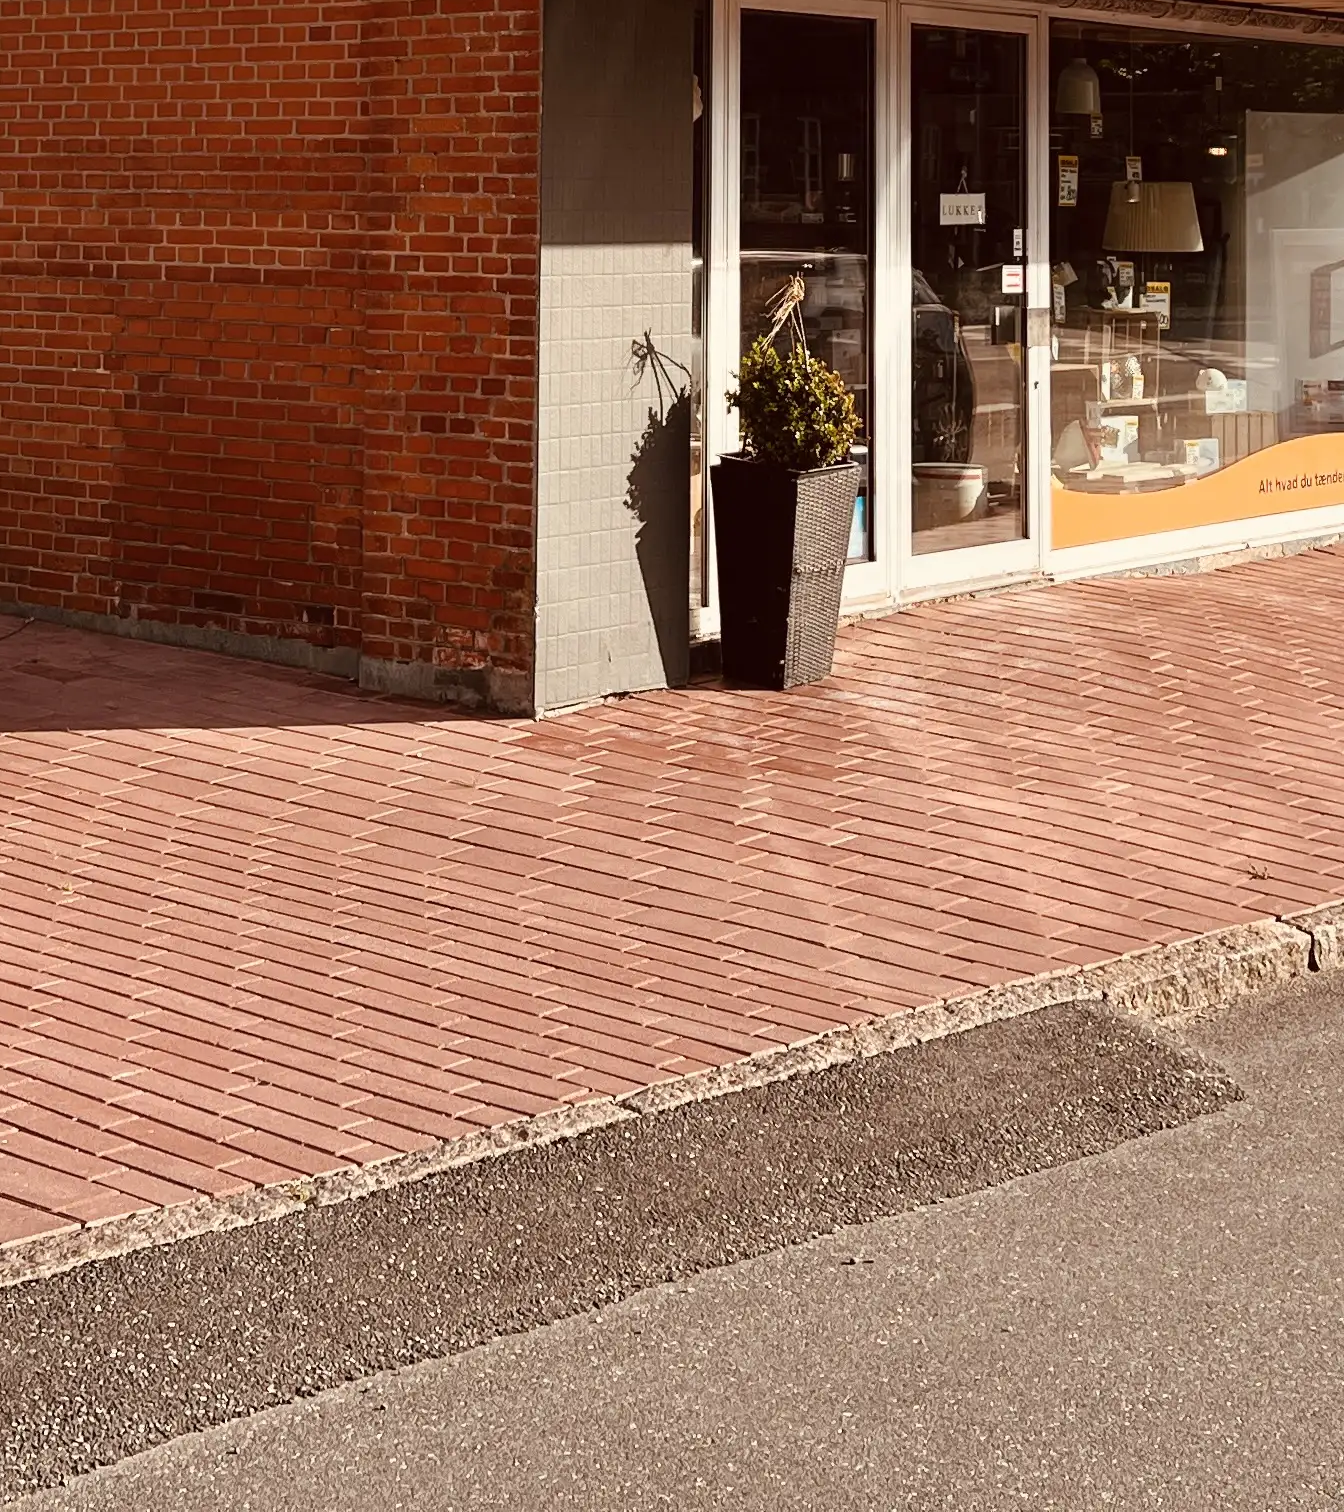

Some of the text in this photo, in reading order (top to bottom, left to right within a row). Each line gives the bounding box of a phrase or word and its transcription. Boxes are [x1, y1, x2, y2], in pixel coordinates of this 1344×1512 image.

[1258, 479, 1273, 494] Alt
[1275, 472, 1298, 492] hvad
[1300, 471, 1312, 489] du
